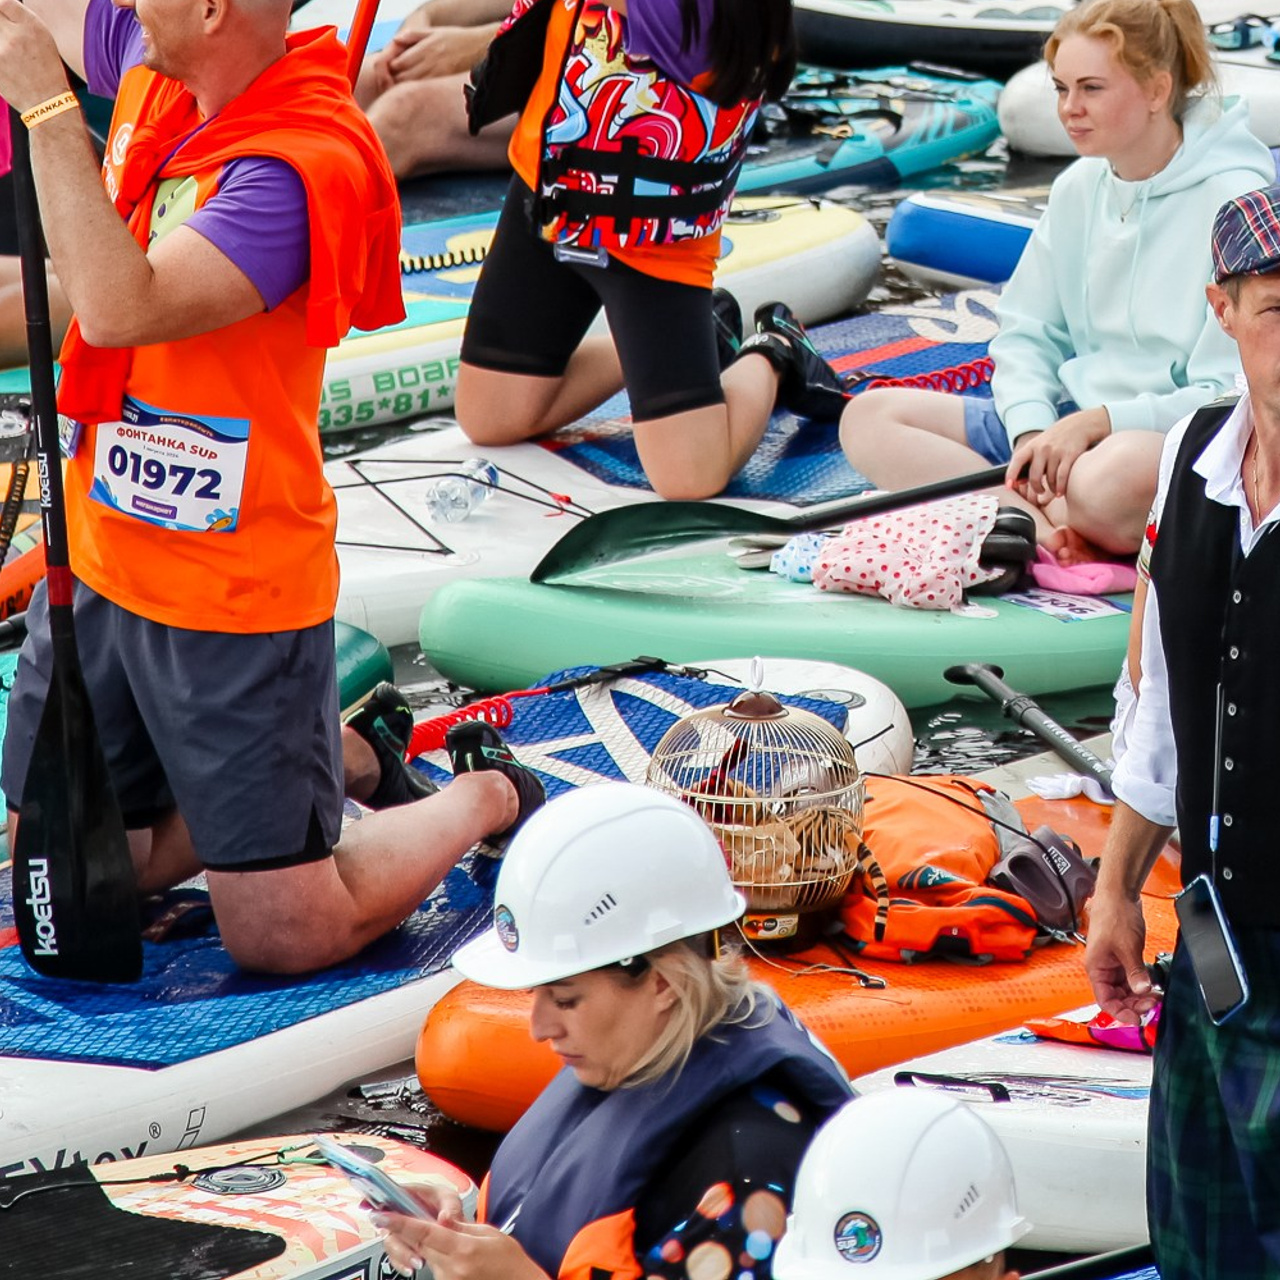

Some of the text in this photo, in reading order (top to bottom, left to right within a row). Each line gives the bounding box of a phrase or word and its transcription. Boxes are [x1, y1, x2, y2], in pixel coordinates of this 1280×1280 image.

[116, 427, 186, 452] ФОНТАНКА
[189, 444, 218, 460] SUP
[108, 444, 222, 500] 01972
[25, 858, 59, 956] koetsu
